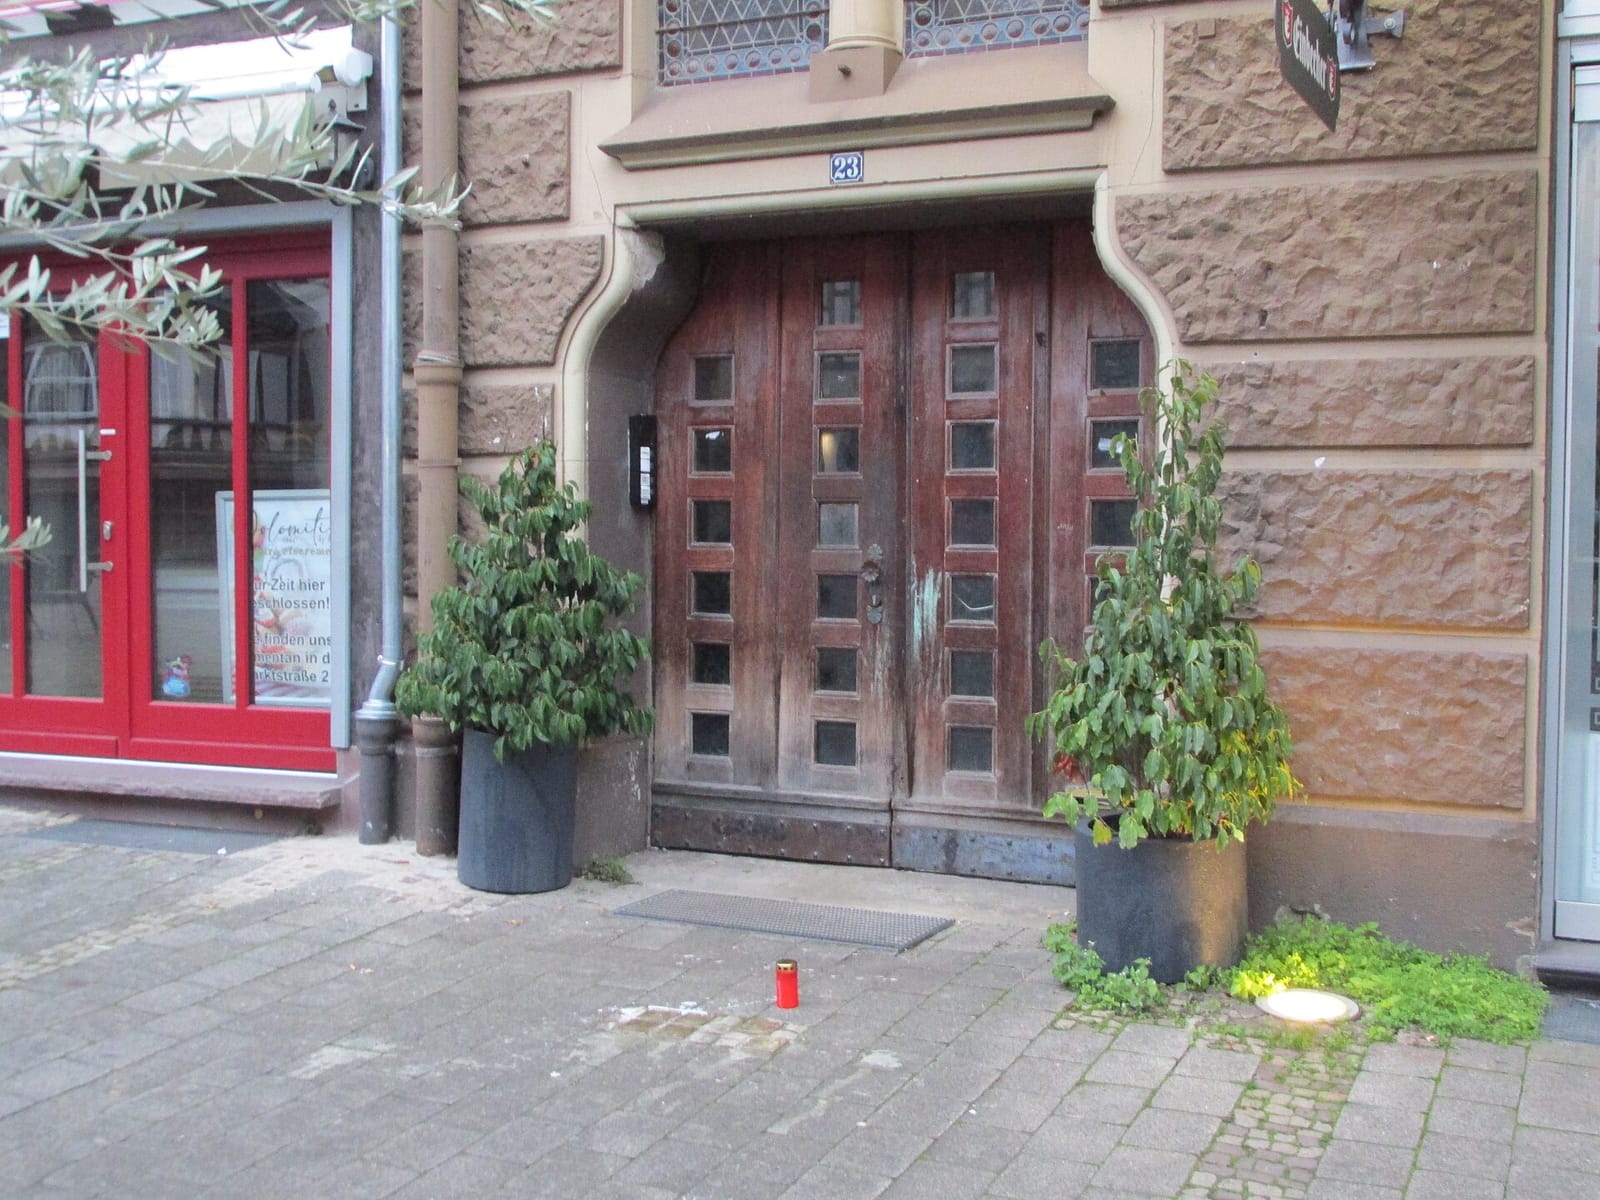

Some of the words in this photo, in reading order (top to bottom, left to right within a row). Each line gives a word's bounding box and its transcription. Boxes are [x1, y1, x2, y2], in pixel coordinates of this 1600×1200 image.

[834, 156, 859, 179] 23
[271, 578, 295, 591] Zeit
[299, 578, 326, 591] hier
[252, 597, 330, 609] eschlossen!
[264, 632, 304, 646] finden
[305, 652, 318, 664] in
